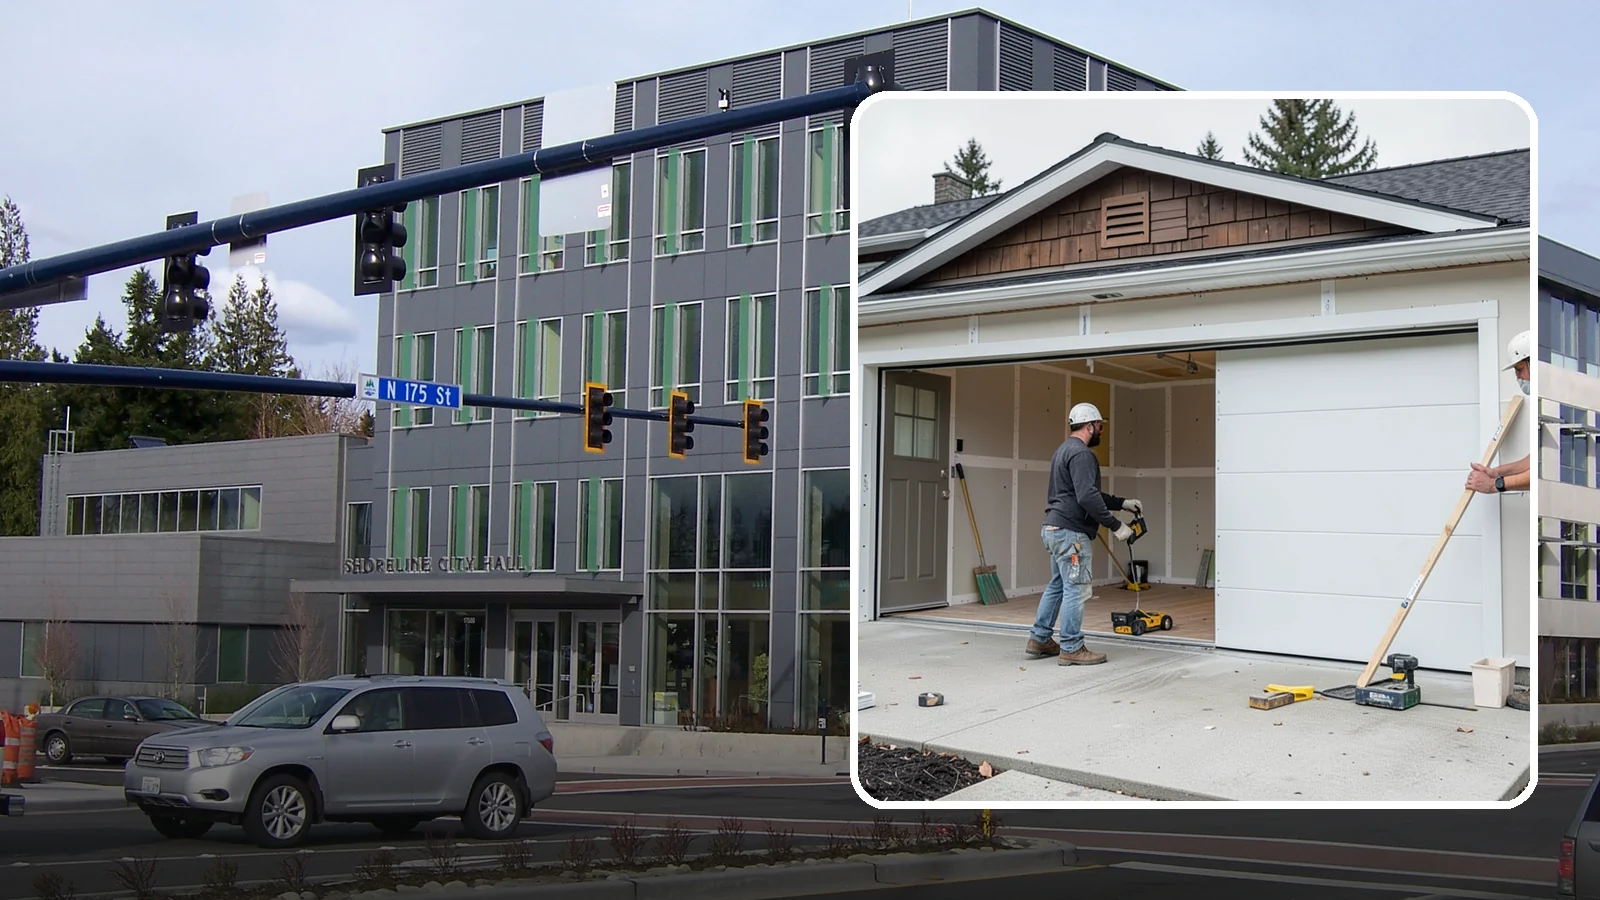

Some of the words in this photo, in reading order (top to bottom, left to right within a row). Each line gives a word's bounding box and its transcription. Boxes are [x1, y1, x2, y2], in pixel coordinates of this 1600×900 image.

[387, 380, 396, 399] N
[405, 382, 427, 403] 175
[436, 386, 451, 406] St
[344, 556, 432, 575] SHORELINE
[438, 556, 476, 573] CITY
[483, 555, 526, 572] HALL
